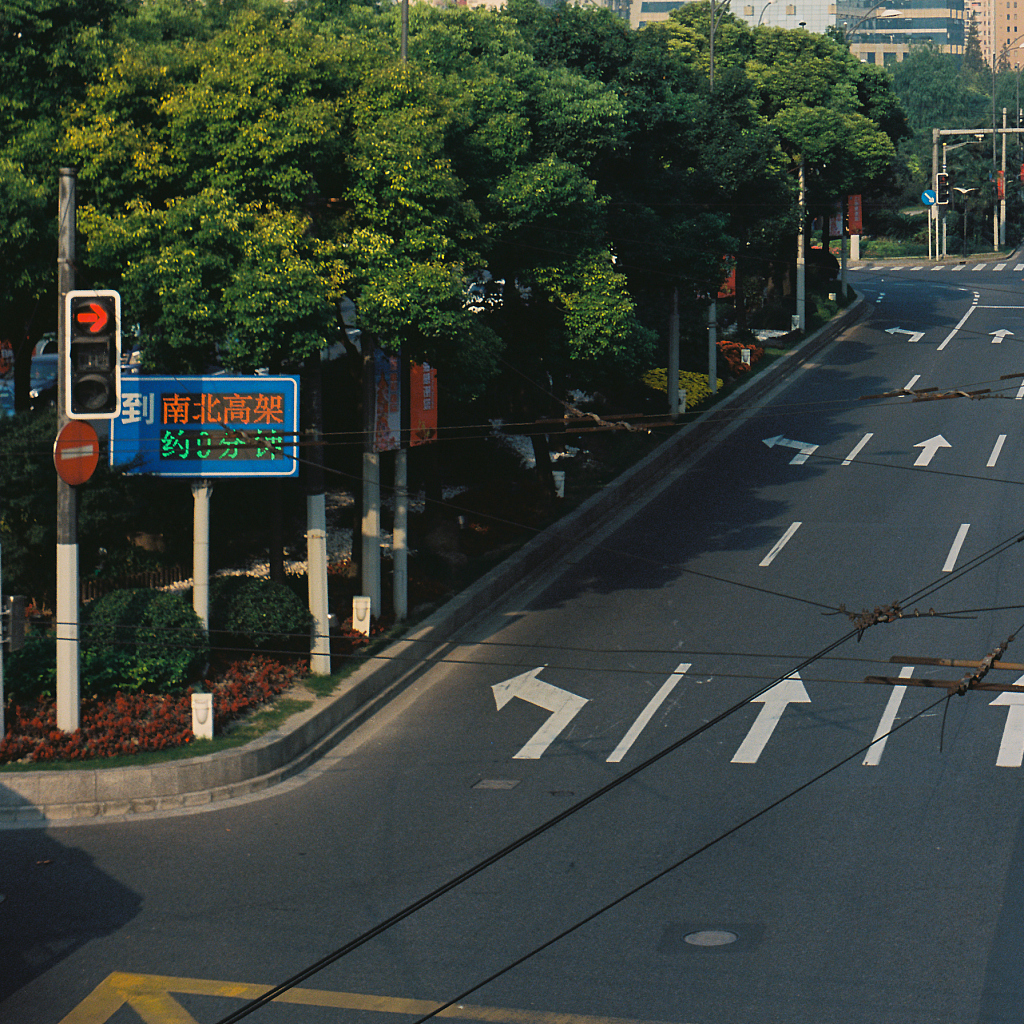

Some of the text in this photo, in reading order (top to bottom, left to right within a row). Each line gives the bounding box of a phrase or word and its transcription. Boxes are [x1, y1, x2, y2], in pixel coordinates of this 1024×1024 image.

[121, 392, 155, 425] 到
[162, 393, 284, 425] 南北高架
